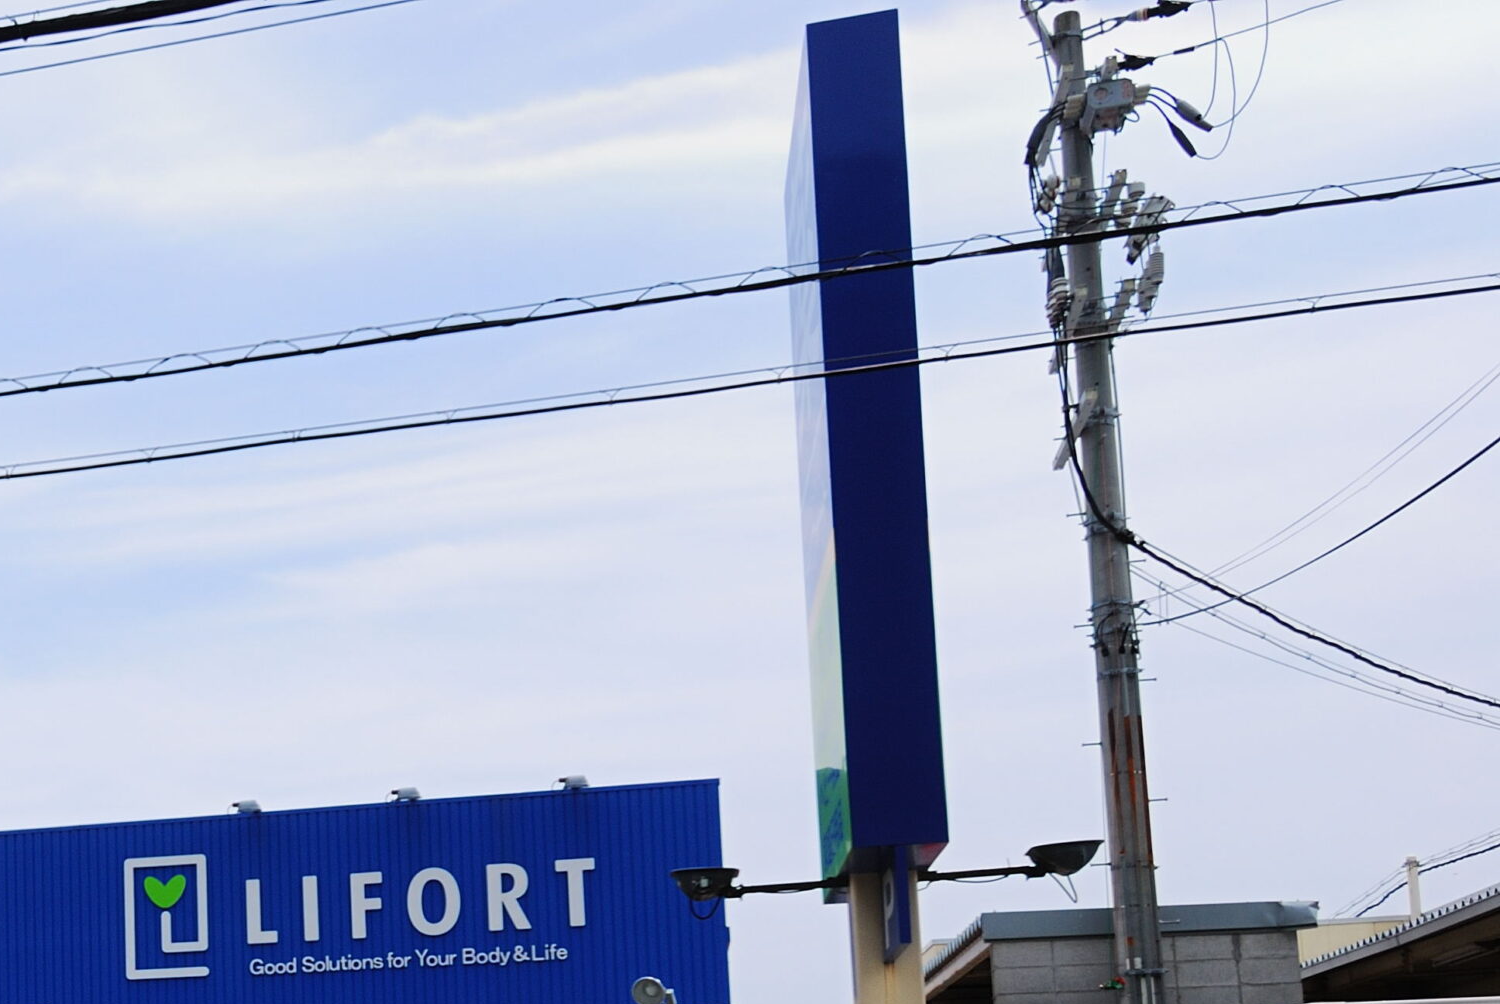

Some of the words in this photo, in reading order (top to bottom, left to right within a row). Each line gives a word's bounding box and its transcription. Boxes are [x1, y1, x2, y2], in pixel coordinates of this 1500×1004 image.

[245, 857, 596, 945] LIFORT
[249, 957, 297, 975] Good
[300, 953, 384, 973] Solutions
[386, 951, 412, 968] for
[415, 948, 457, 967] Your
